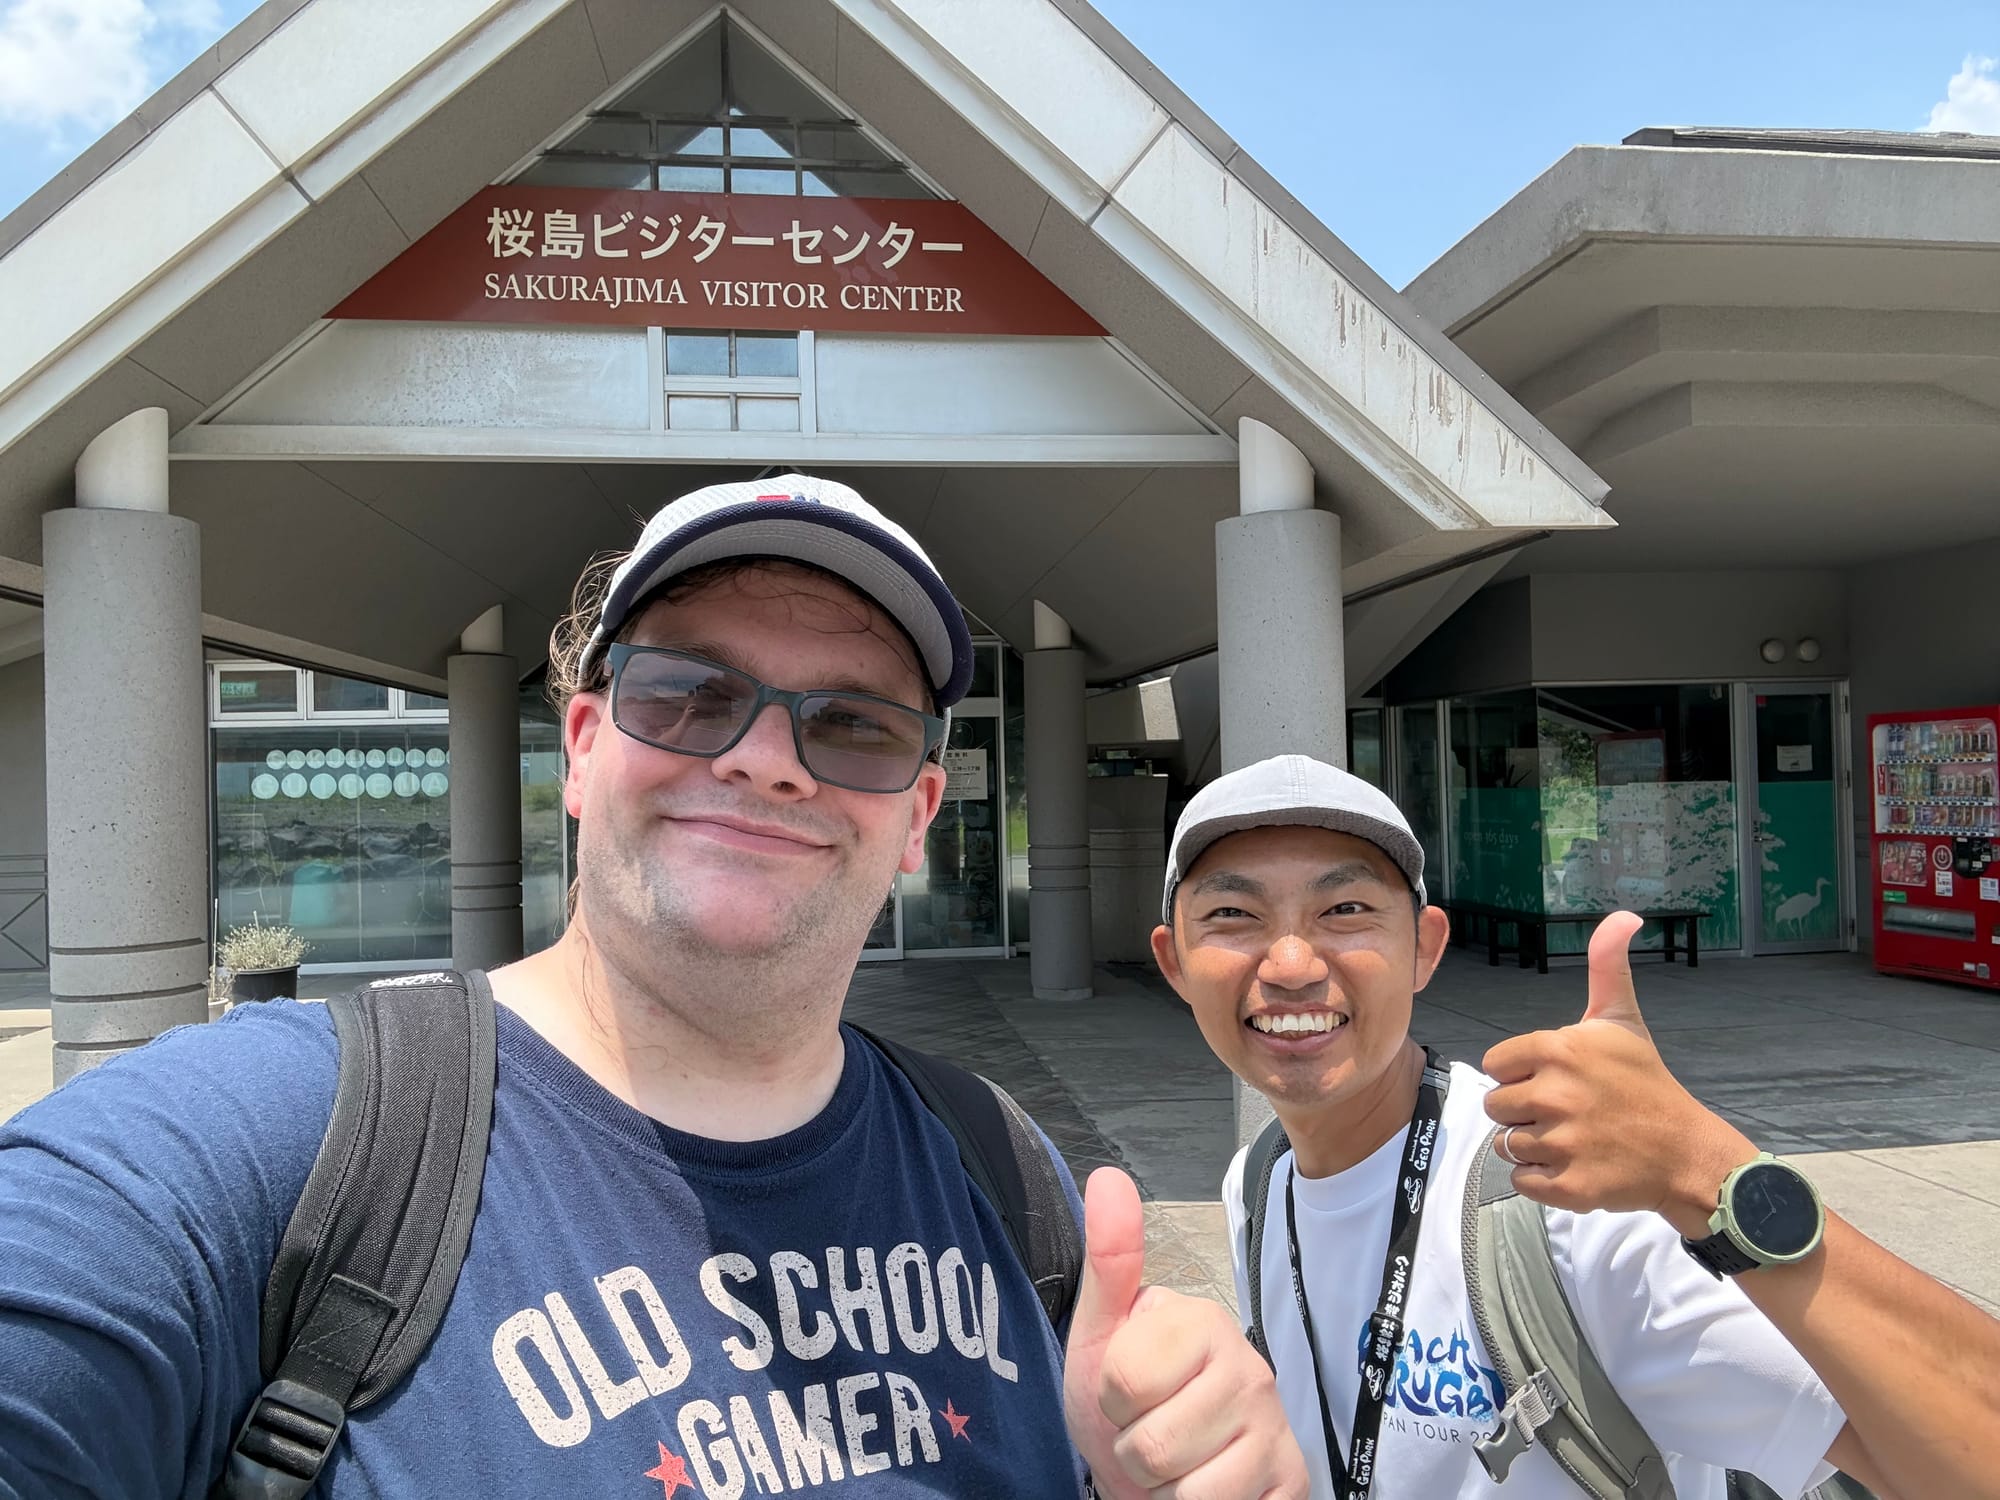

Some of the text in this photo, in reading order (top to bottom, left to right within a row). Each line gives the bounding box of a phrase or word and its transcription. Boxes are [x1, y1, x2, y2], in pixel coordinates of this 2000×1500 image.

[486, 207, 964, 269] 桜島ビジターセンター
[484, 273, 965, 313] SAKURAJIMA VISITOR CENTER
[492, 1242, 1018, 1448] OLD SCHOOL
[677, 1371, 942, 1500] GAMER
[1414, 1421, 1461, 1443] TOUR
